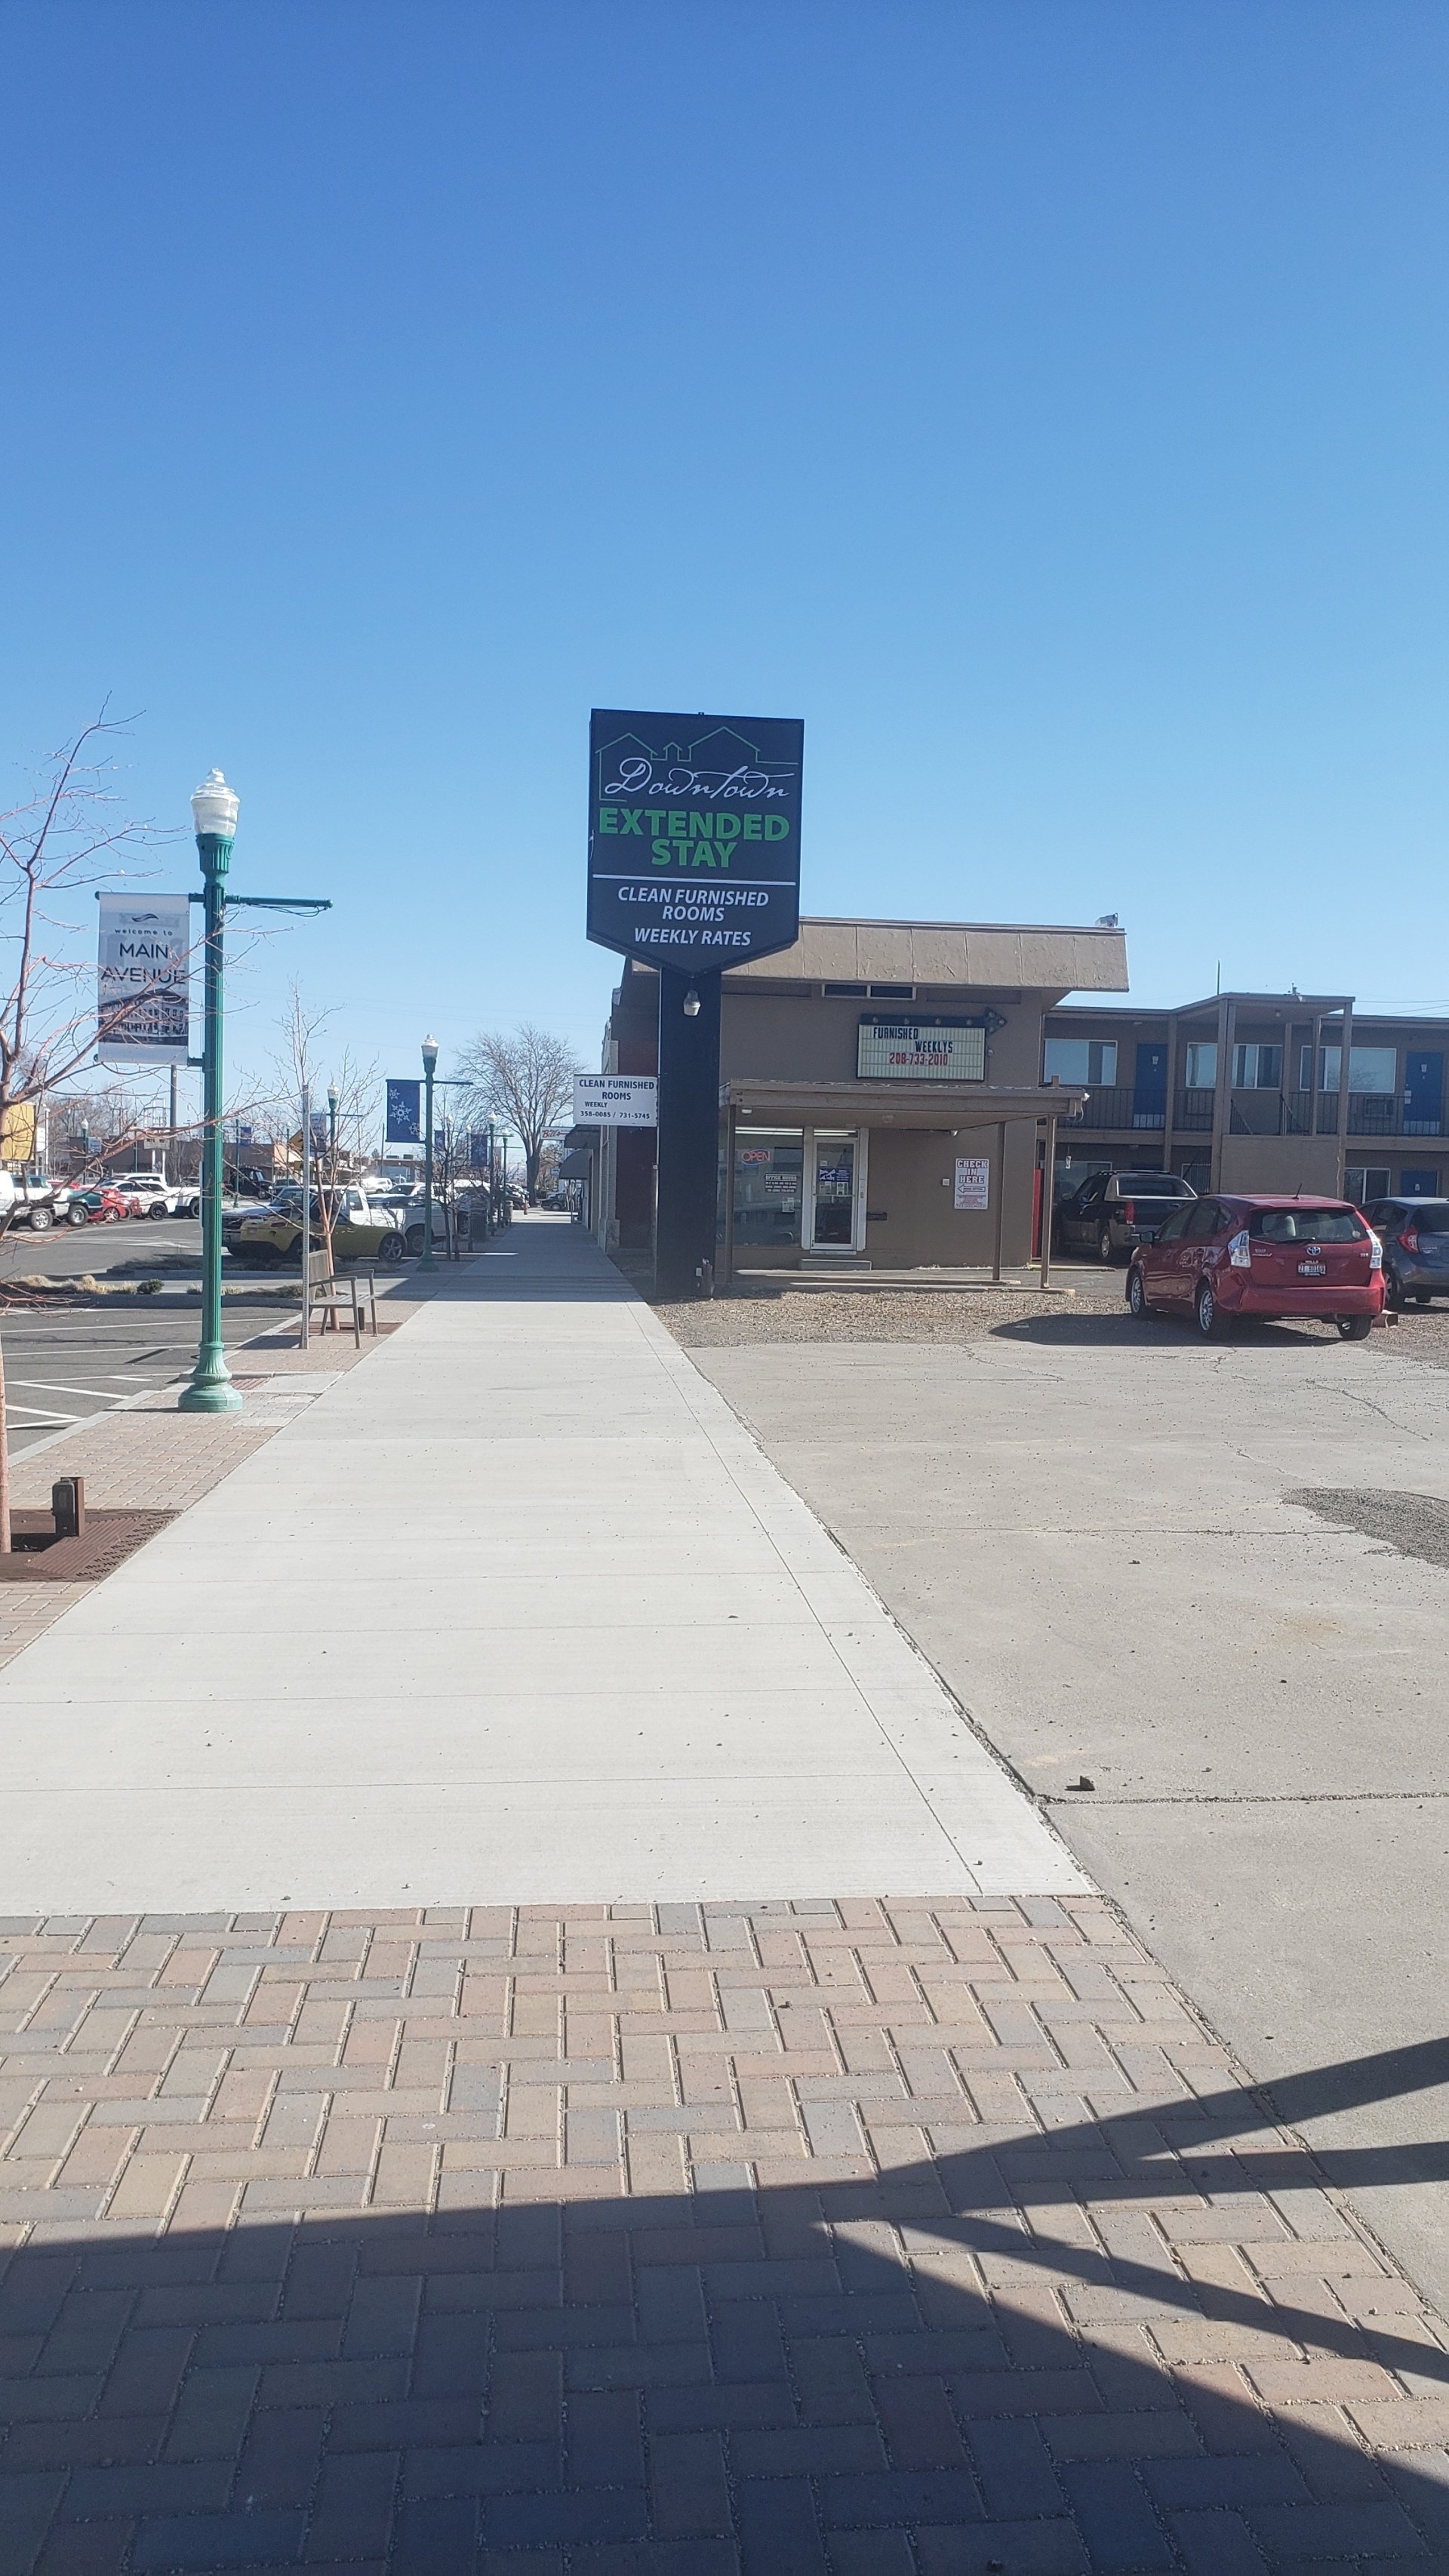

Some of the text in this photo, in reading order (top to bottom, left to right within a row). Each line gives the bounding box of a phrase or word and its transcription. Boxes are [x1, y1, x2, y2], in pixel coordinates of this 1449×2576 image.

[605, 757, 795, 799] Downtown
[598, 807, 789, 842] EXTENDED
[651, 839, 737, 868] STAY
[617, 886, 769, 906] CLEAN FURNISHED
[662, 906, 724, 922] ROOMS
[635, 928, 751, 946] WEEKLY RATES
[119, 942, 169, 959] MAIN
[100, 966, 186, 984] AVENUE
[873, 1026, 918, 1039] FURNISHED
[915, 1041, 953, 1054] WEEKLYS
[889, 1052, 949, 1066] 208-733-2010
[579, 1079, 654, 1090] CLEAN FURNISHED
[601, 1091, 632, 1100] ROOMS
[742, 1151, 771, 1162] OPEN
[957, 1159, 988, 1168] CHECK
[959, 1175, 984, 1183] HERE
[967, 1168, 977, 1176] IN
